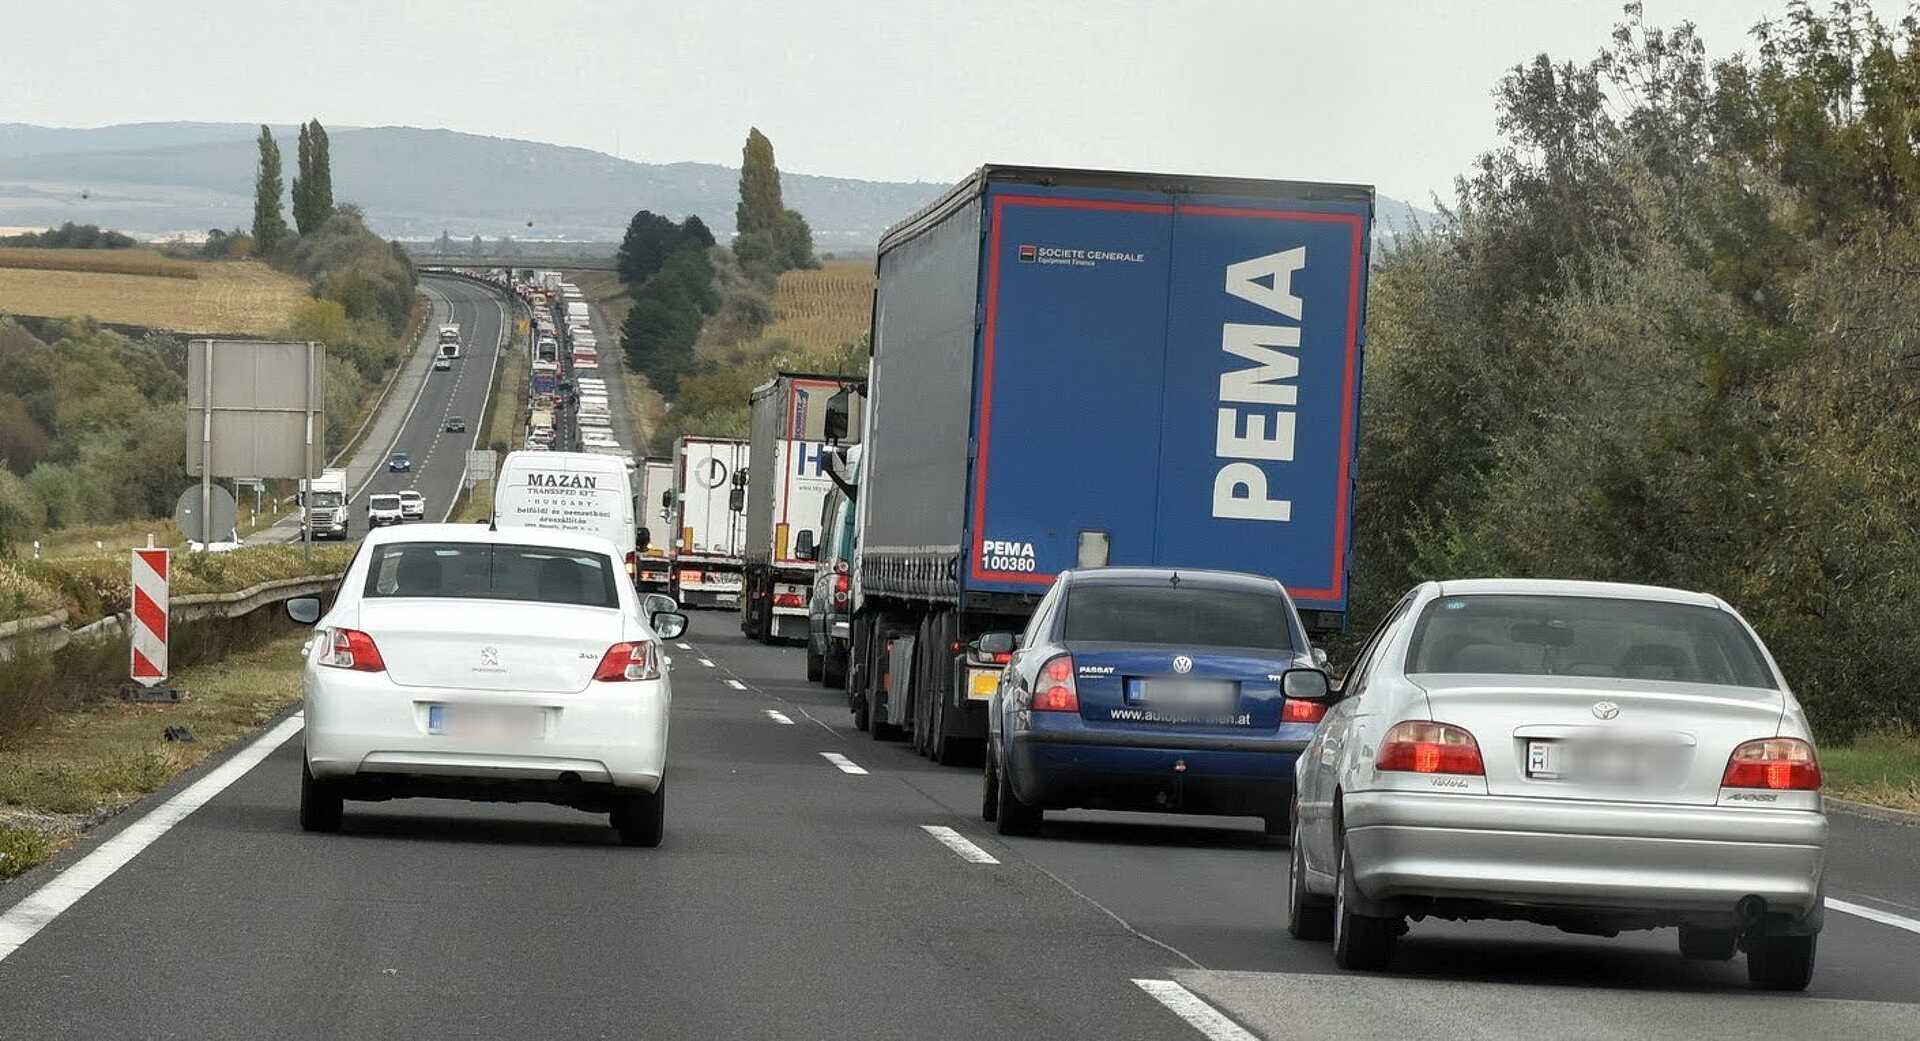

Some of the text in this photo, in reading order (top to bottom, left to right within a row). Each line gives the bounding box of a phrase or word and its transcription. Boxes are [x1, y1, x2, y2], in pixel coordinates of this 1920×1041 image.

[1038, 247, 1144, 262] SOCIETE GENERALE
[1212, 246, 1306, 521] PEMA
[527, 474, 597, 488] MAZÁN
[983, 541, 1035, 557] PEMA
[982, 555, 1036, 572] 100380
